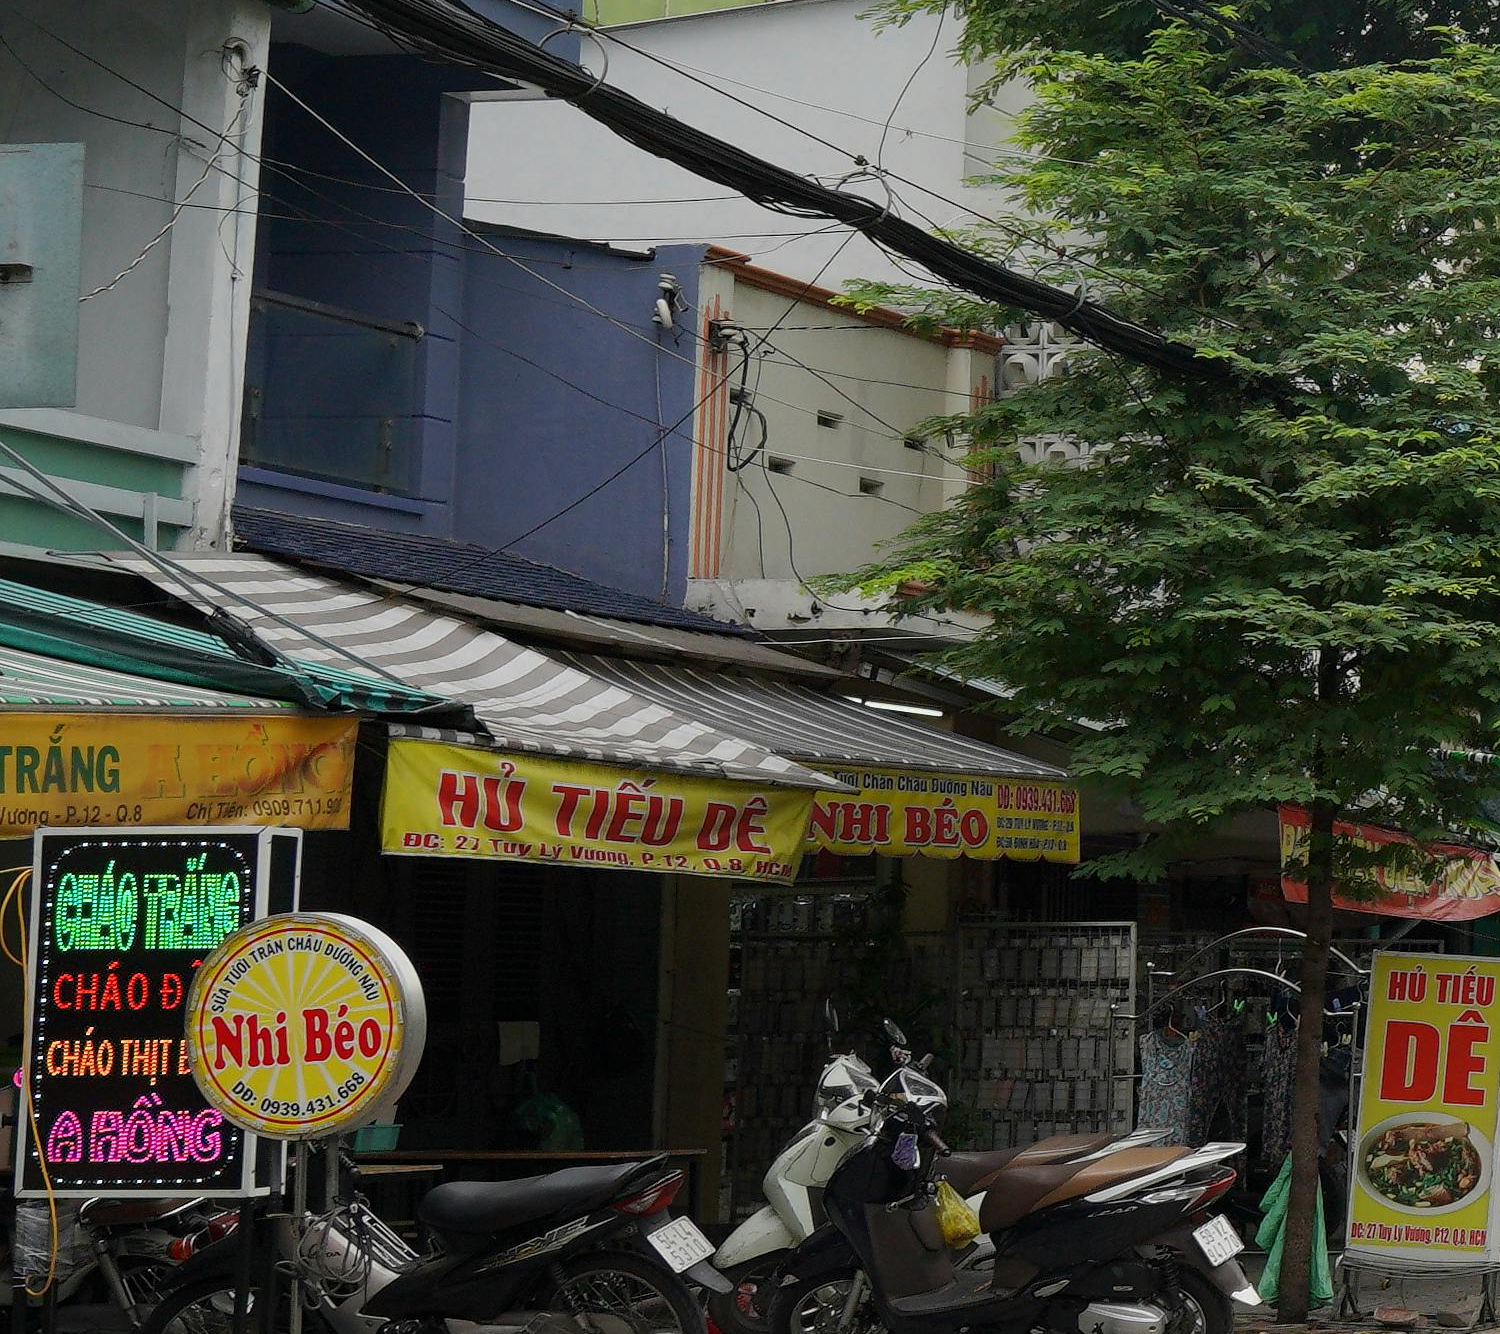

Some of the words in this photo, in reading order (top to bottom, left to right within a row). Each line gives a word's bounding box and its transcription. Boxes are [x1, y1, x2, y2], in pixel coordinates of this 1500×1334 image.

[116, 804, 142, 823] Q.8
[437, 762, 527, 833] HỦ
[552, 779, 684, 846] TIẾU
[697, 797, 772, 855] DÊ
[806, 801, 891, 844] NHI
[903, 798, 989, 847] BÉO
[455, 835, 479, 851] 27
[539, 842, 562, 861] Lý
[55, 859, 138, 952] CHÁO
[143, 852, 240, 951] TRẮNG
[252, 938, 284, 964] TRÂN
[287, 935, 323, 952] CHÂU
[53, 960, 149, 1011] CHÁO
[1387, 965, 1427, 1003] HỦ
[1435, 965, 1495, 1007] TIẾU
[46, 1027, 114, 1077] CHÁO
[120, 1038, 173, 1086] THỊT
[211, 1011, 291, 1070] Nhi
[303, 1004, 383, 1063] Béo
[1379, 1008, 1490, 1106] DÊ
[260, 1070, 366, 1117] 0939.431.668
[89, 1092, 224, 1164] HỒNG
[1367, 1222, 1377, 1239] 27
